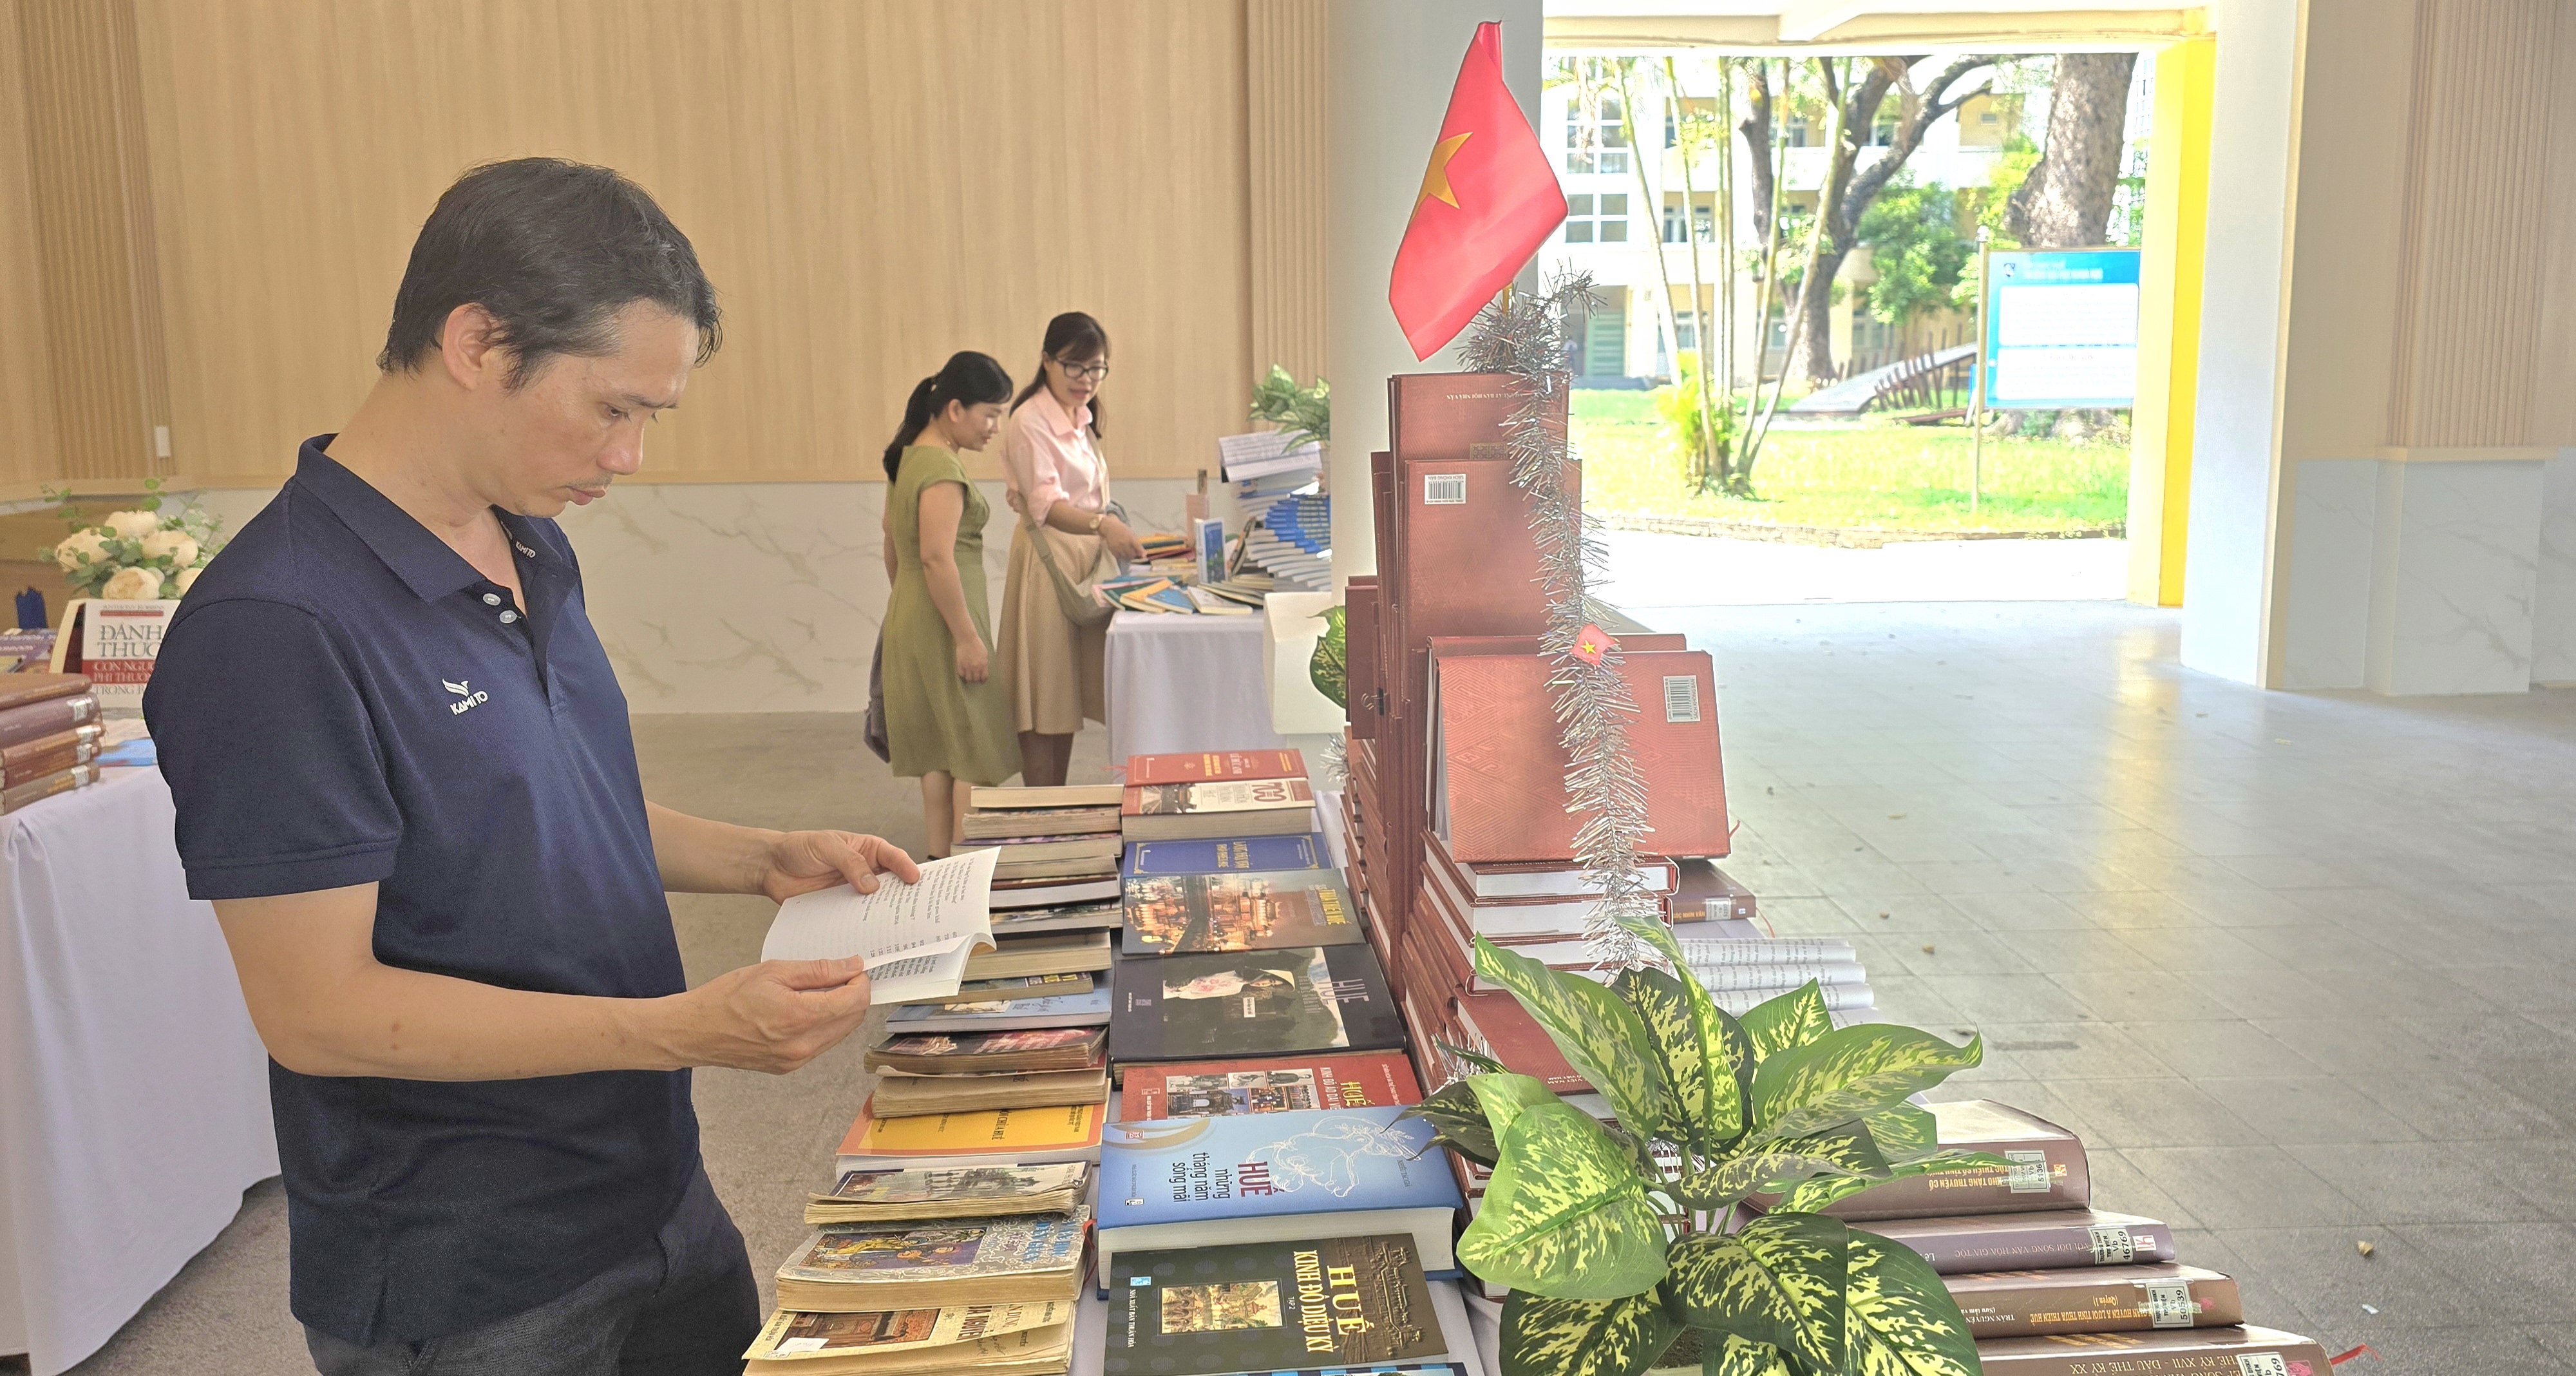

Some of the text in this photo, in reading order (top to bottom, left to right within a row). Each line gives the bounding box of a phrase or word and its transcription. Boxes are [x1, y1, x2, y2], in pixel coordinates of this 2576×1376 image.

[515, 541, 536, 558] KAMITO
[450, 691, 488, 716] KAMITO
[1252, 781, 1287, 803] 700
[1340, 1082, 1376, 1107] HUẾ
[1189, 1152, 1212, 1201] tháng năm
[2036, 1159, 2045, 1183] 5136
[1168, 1162, 1193, 1203] sống mãi
[1212, 1169, 1233, 1199] những
[1238, 1161, 1285, 1197] HUẾ
[1928, 1179, 1939, 1191] CỔ
[1939, 1177, 1968, 1189] TRUYỆN
[1967, 1178, 1987, 1189] TÀNG
[2011, 1246, 2030, 1256] VĂN
[2112, 1240, 2119, 1252] Vb
[2118, 1230, 2131, 1261] 46769
[1924, 1252, 1935, 1263] Lê
[1953, 1248, 1972, 1259] TỘC
[1973, 1248, 1989, 1257] GIA
[1293, 1250, 1340, 1353] KINH ĐÔ DIỆU KỲ
[1327, 1264, 1375, 1336] HUẾ
[2093, 1295, 2099, 1307] 1)
[2175, 1290, 2188, 1320] 50539
[1982, 1306, 1996, 1315] (Sưu
[2106, 1310, 2112, 1319] A
[2112, 1308, 2132, 1321] HUYỆN
[2029, 1314, 2043, 1326] HUẾ
[2069, 1363, 2088, 1375] XX
[2109, 1361, 2135, 1375] THẾ
[2172, 1356, 2197, 1369] XVII
